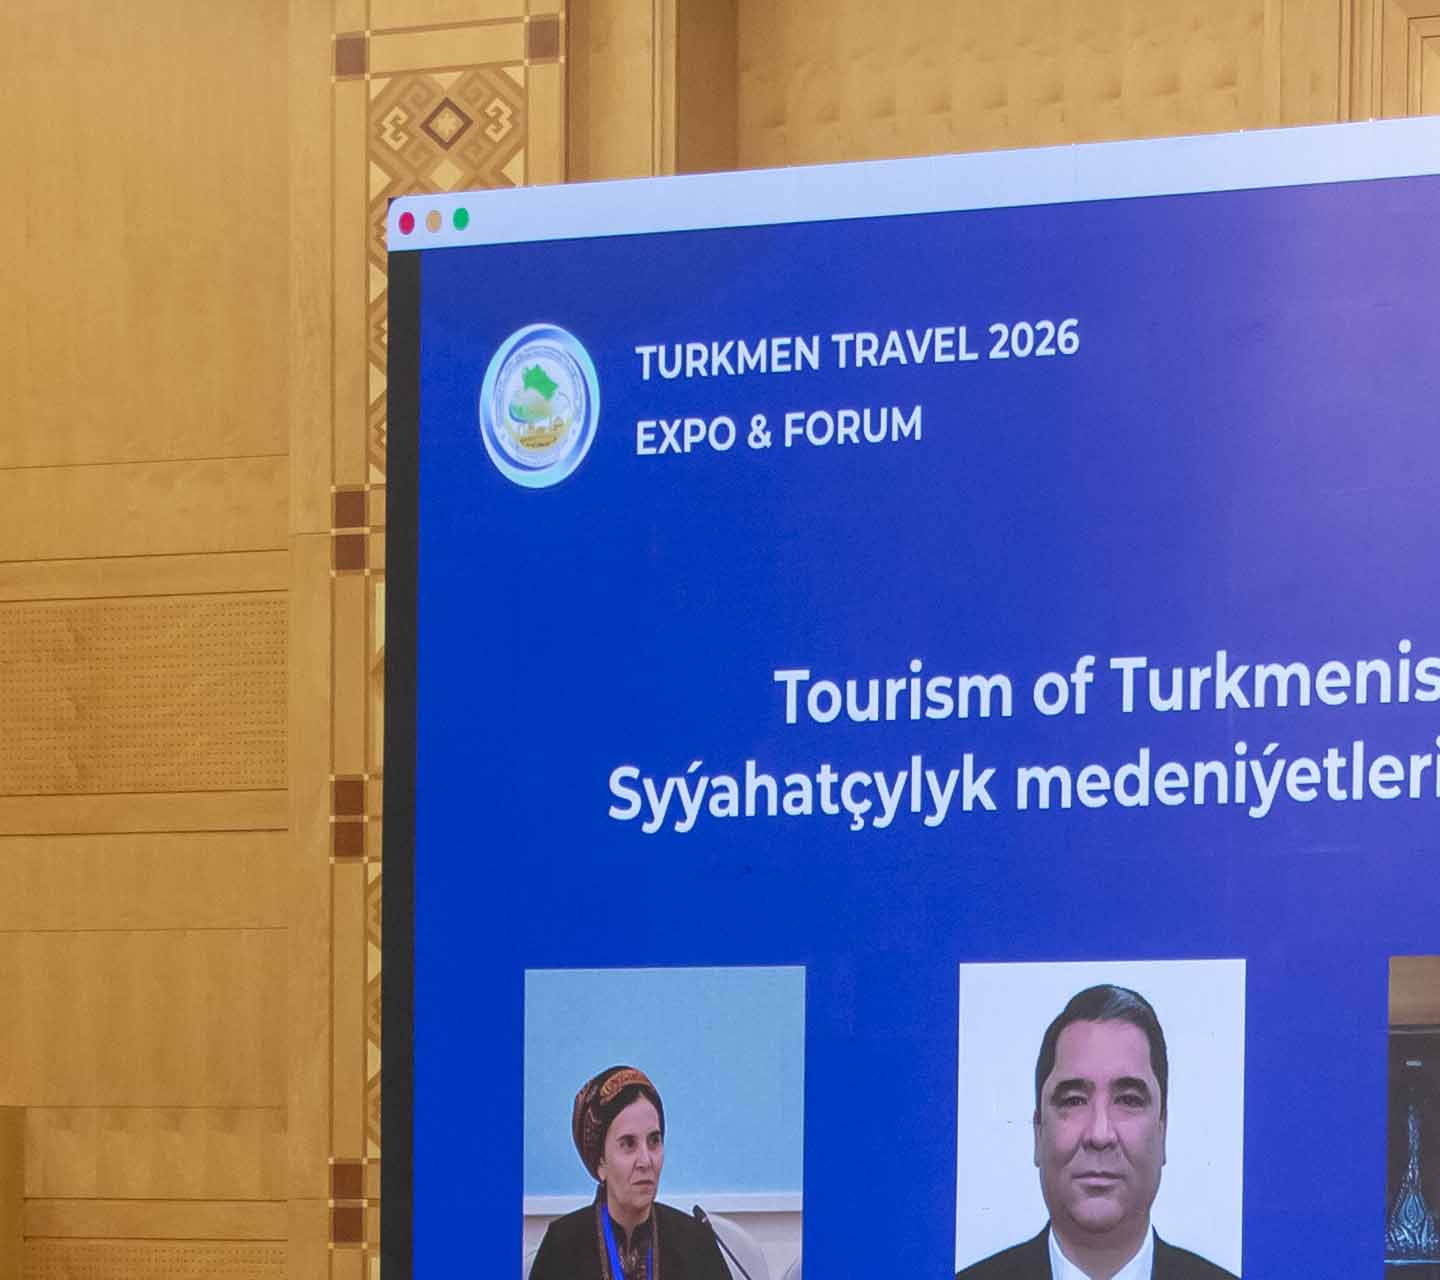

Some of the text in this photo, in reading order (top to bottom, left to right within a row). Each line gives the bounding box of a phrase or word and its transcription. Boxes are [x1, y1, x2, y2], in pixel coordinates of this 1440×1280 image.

[635, 317, 1080, 380] TURKMEN TRAVEL 2026
[636, 405, 922, 455] EXPO & FORUM
[774, 659, 1012, 724] Tourism
[1033, 655, 1096, 715] of
[608, 753, 997, 834] Syýahatçylyk
